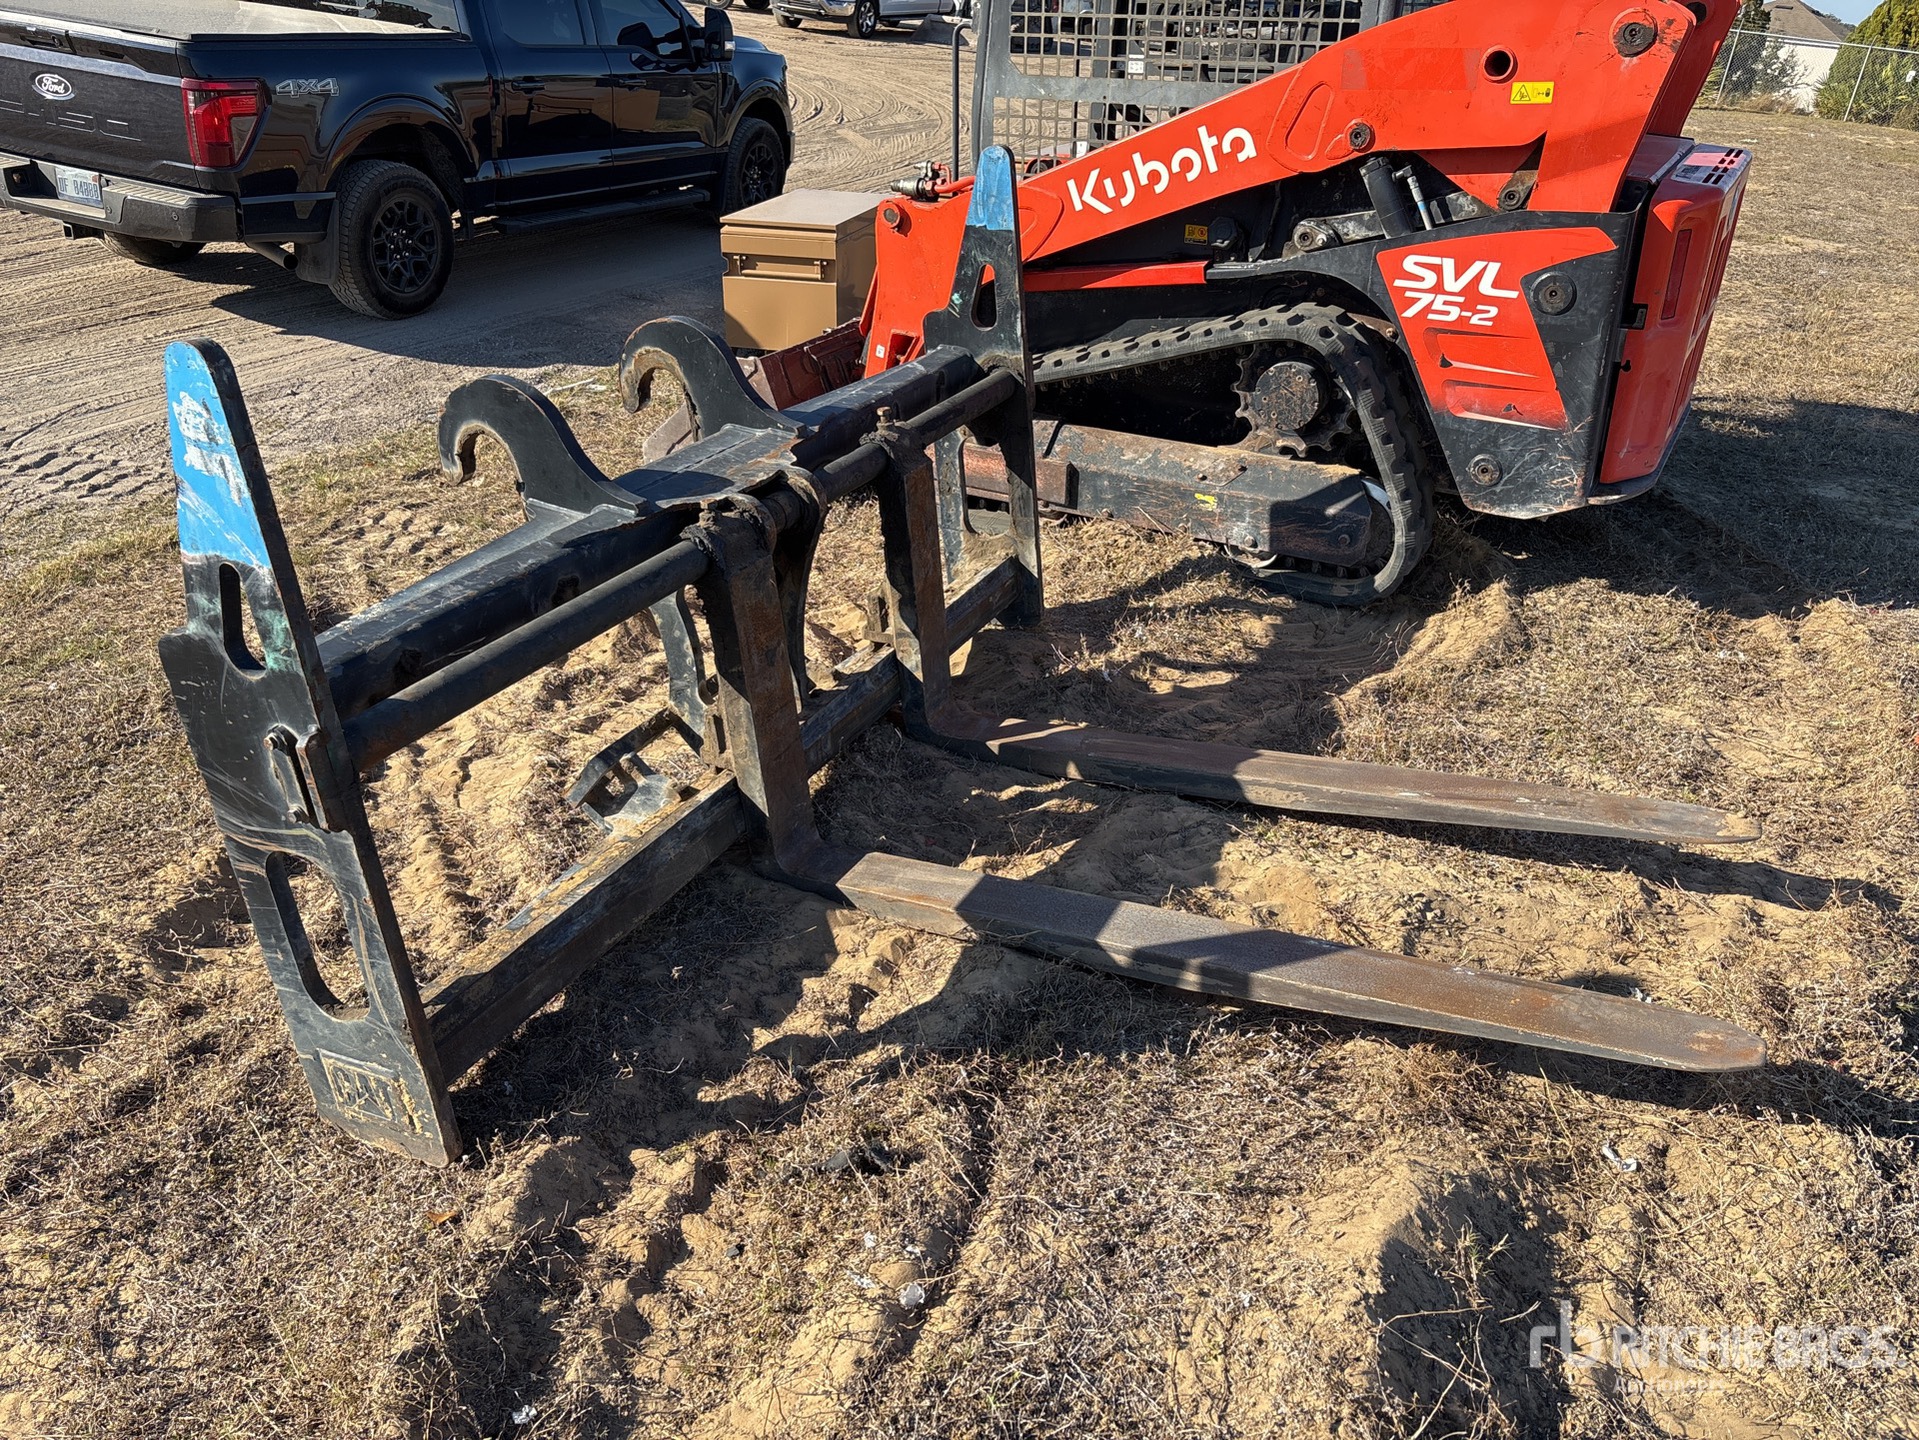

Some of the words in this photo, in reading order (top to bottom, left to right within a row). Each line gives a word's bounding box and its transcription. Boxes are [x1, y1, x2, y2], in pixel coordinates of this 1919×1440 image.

[41, 75, 66, 94] Ford
[1067, 125, 1257, 215] Kubota
[1393, 254, 1520, 299] SVL
[1400, 290, 1499, 326] 75-2
